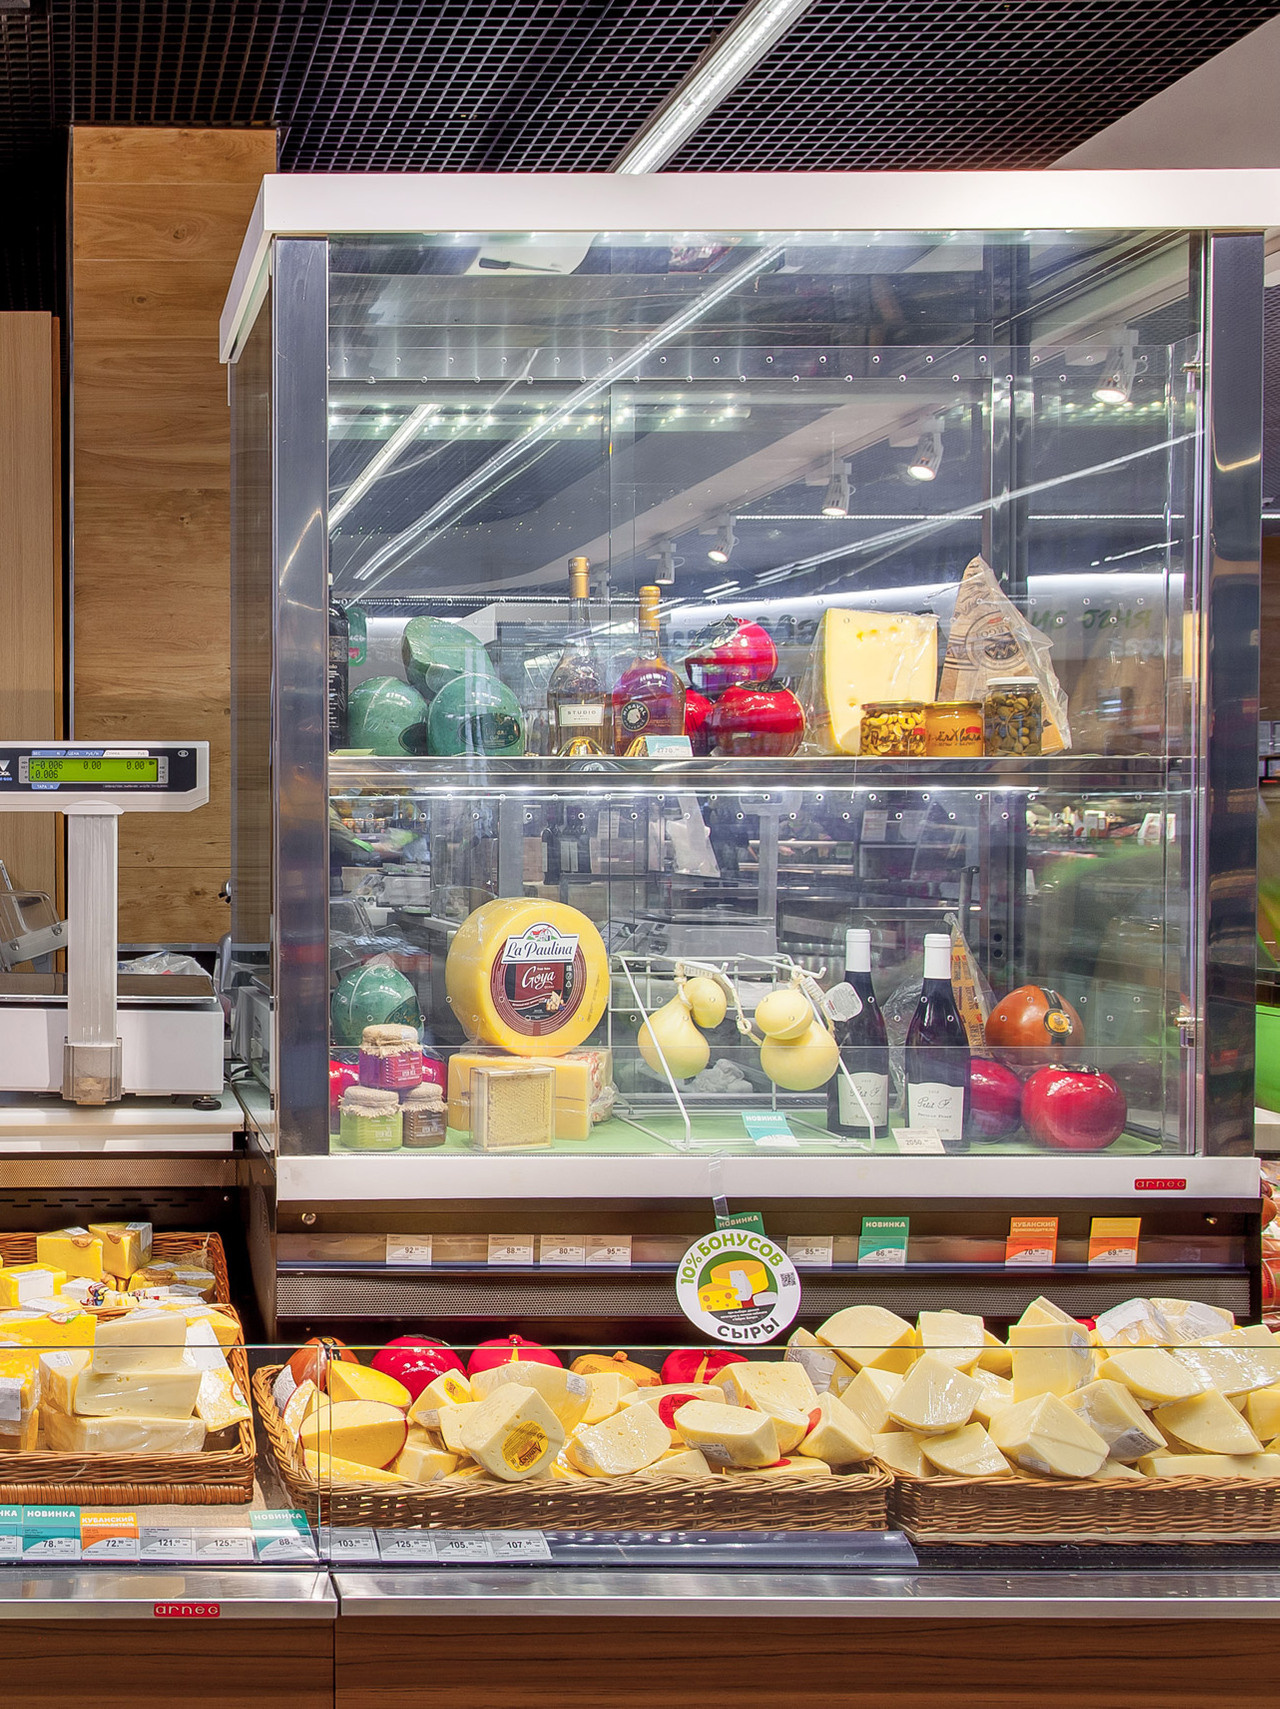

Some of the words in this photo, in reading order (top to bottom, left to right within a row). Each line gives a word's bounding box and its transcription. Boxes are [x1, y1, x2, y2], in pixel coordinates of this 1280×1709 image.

[622, 703, 647, 716] MIRAVAL
[83, 761, 102, 770] 0.00
[126, 761, 145, 770] 0.00
[35, 770, 59, 779] 0.006
[506, 942, 522, 958] La
[524, 941, 573, 958] Paulina
[521, 966, 556, 990] Goya
[719, 1215, 759, 1228] НОВИНКА
[865, 1220, 906, 1229] НОВИНКА
[1012, 1220, 1056, 1228] КУБАНСКИЙ
[680, 1252, 702, 1285] 10%
[697, 1233, 784, 1267] БОНУСОВ
[717, 1317, 781, 1339] СЫРЫ
[81, 1516, 135, 1524] КУБАНСКИЙ
[253, 1512, 303, 1521] НОВИНКА
[43, 1540, 57, 1548] 78.
[159, 1539, 177, 1547] 121.
[338, 1540, 357, 1548] 103.
[395, 1540, 414, 1548] 125.
[449, 1541, 468, 1549] 105.
[506, 1541, 526, 1549] 107.
